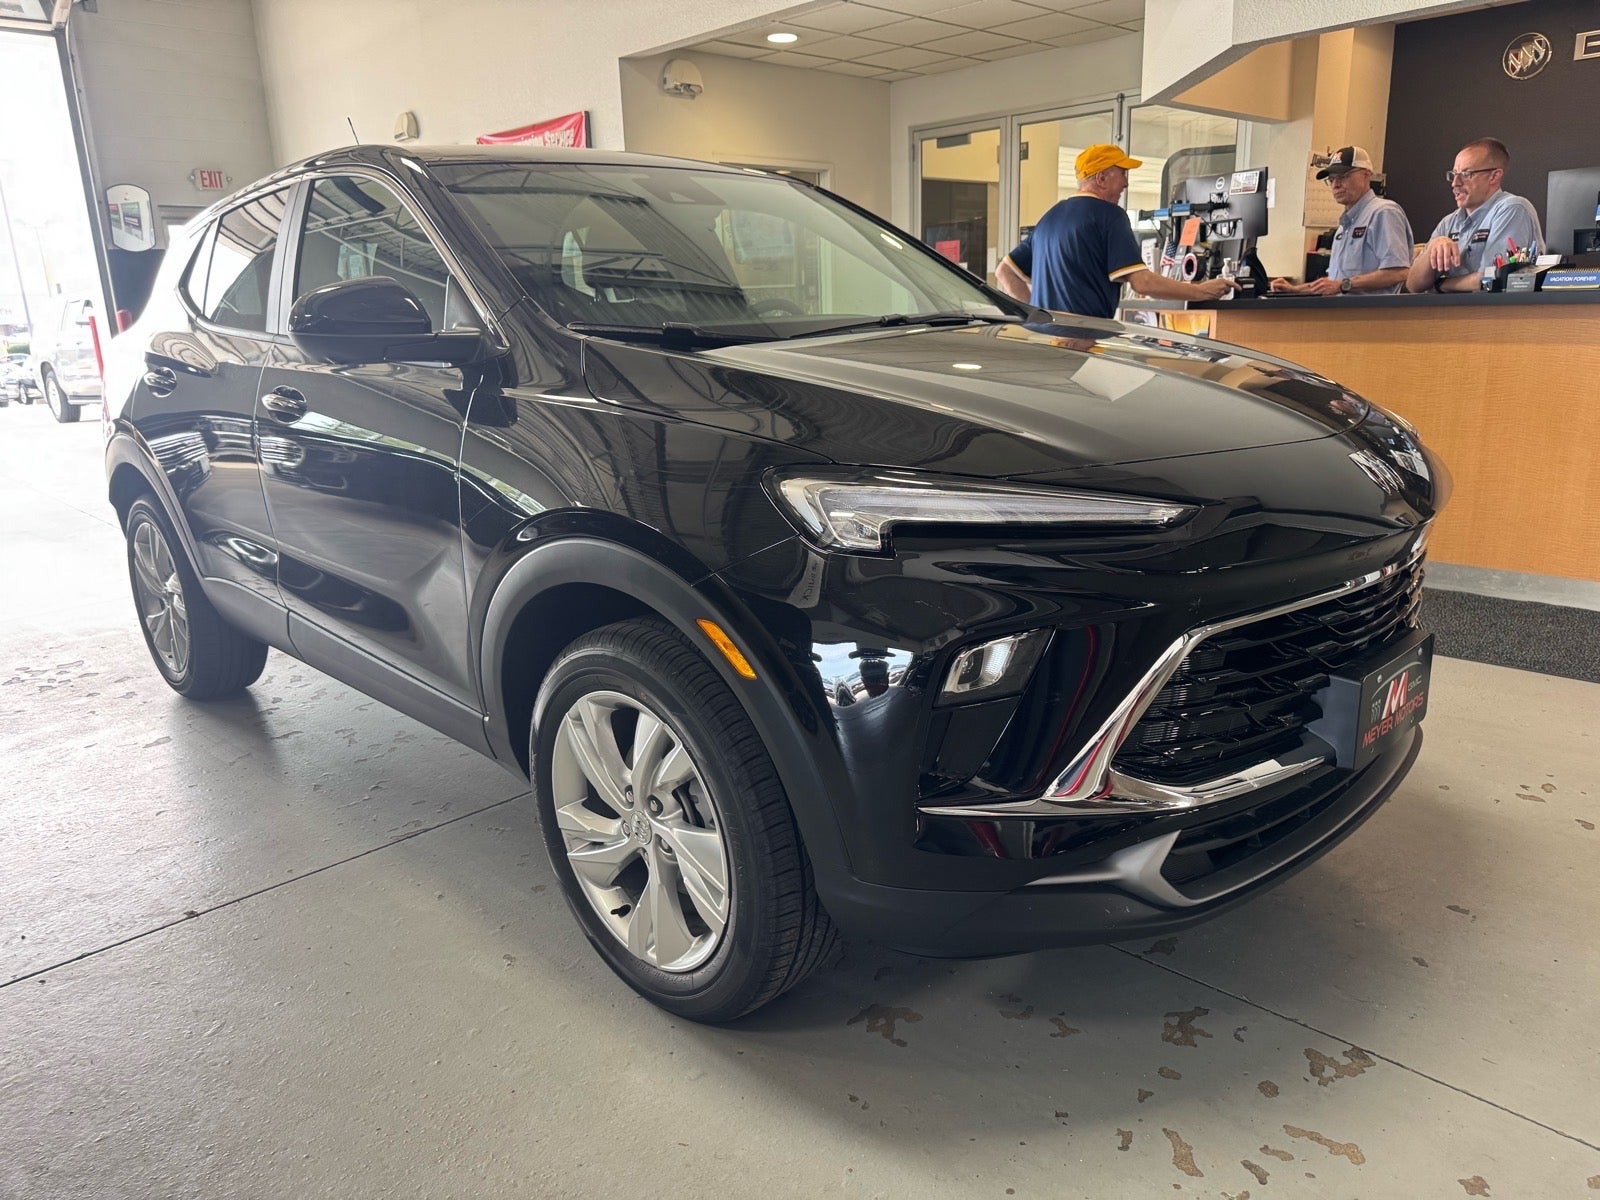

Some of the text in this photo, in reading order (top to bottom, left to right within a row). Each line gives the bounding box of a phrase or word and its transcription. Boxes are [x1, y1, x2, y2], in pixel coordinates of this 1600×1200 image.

[200, 170, 223, 188] EXIT
[1408, 675, 1422, 692] GMC
[1362, 692, 1424, 748] MEYER MOTORS
